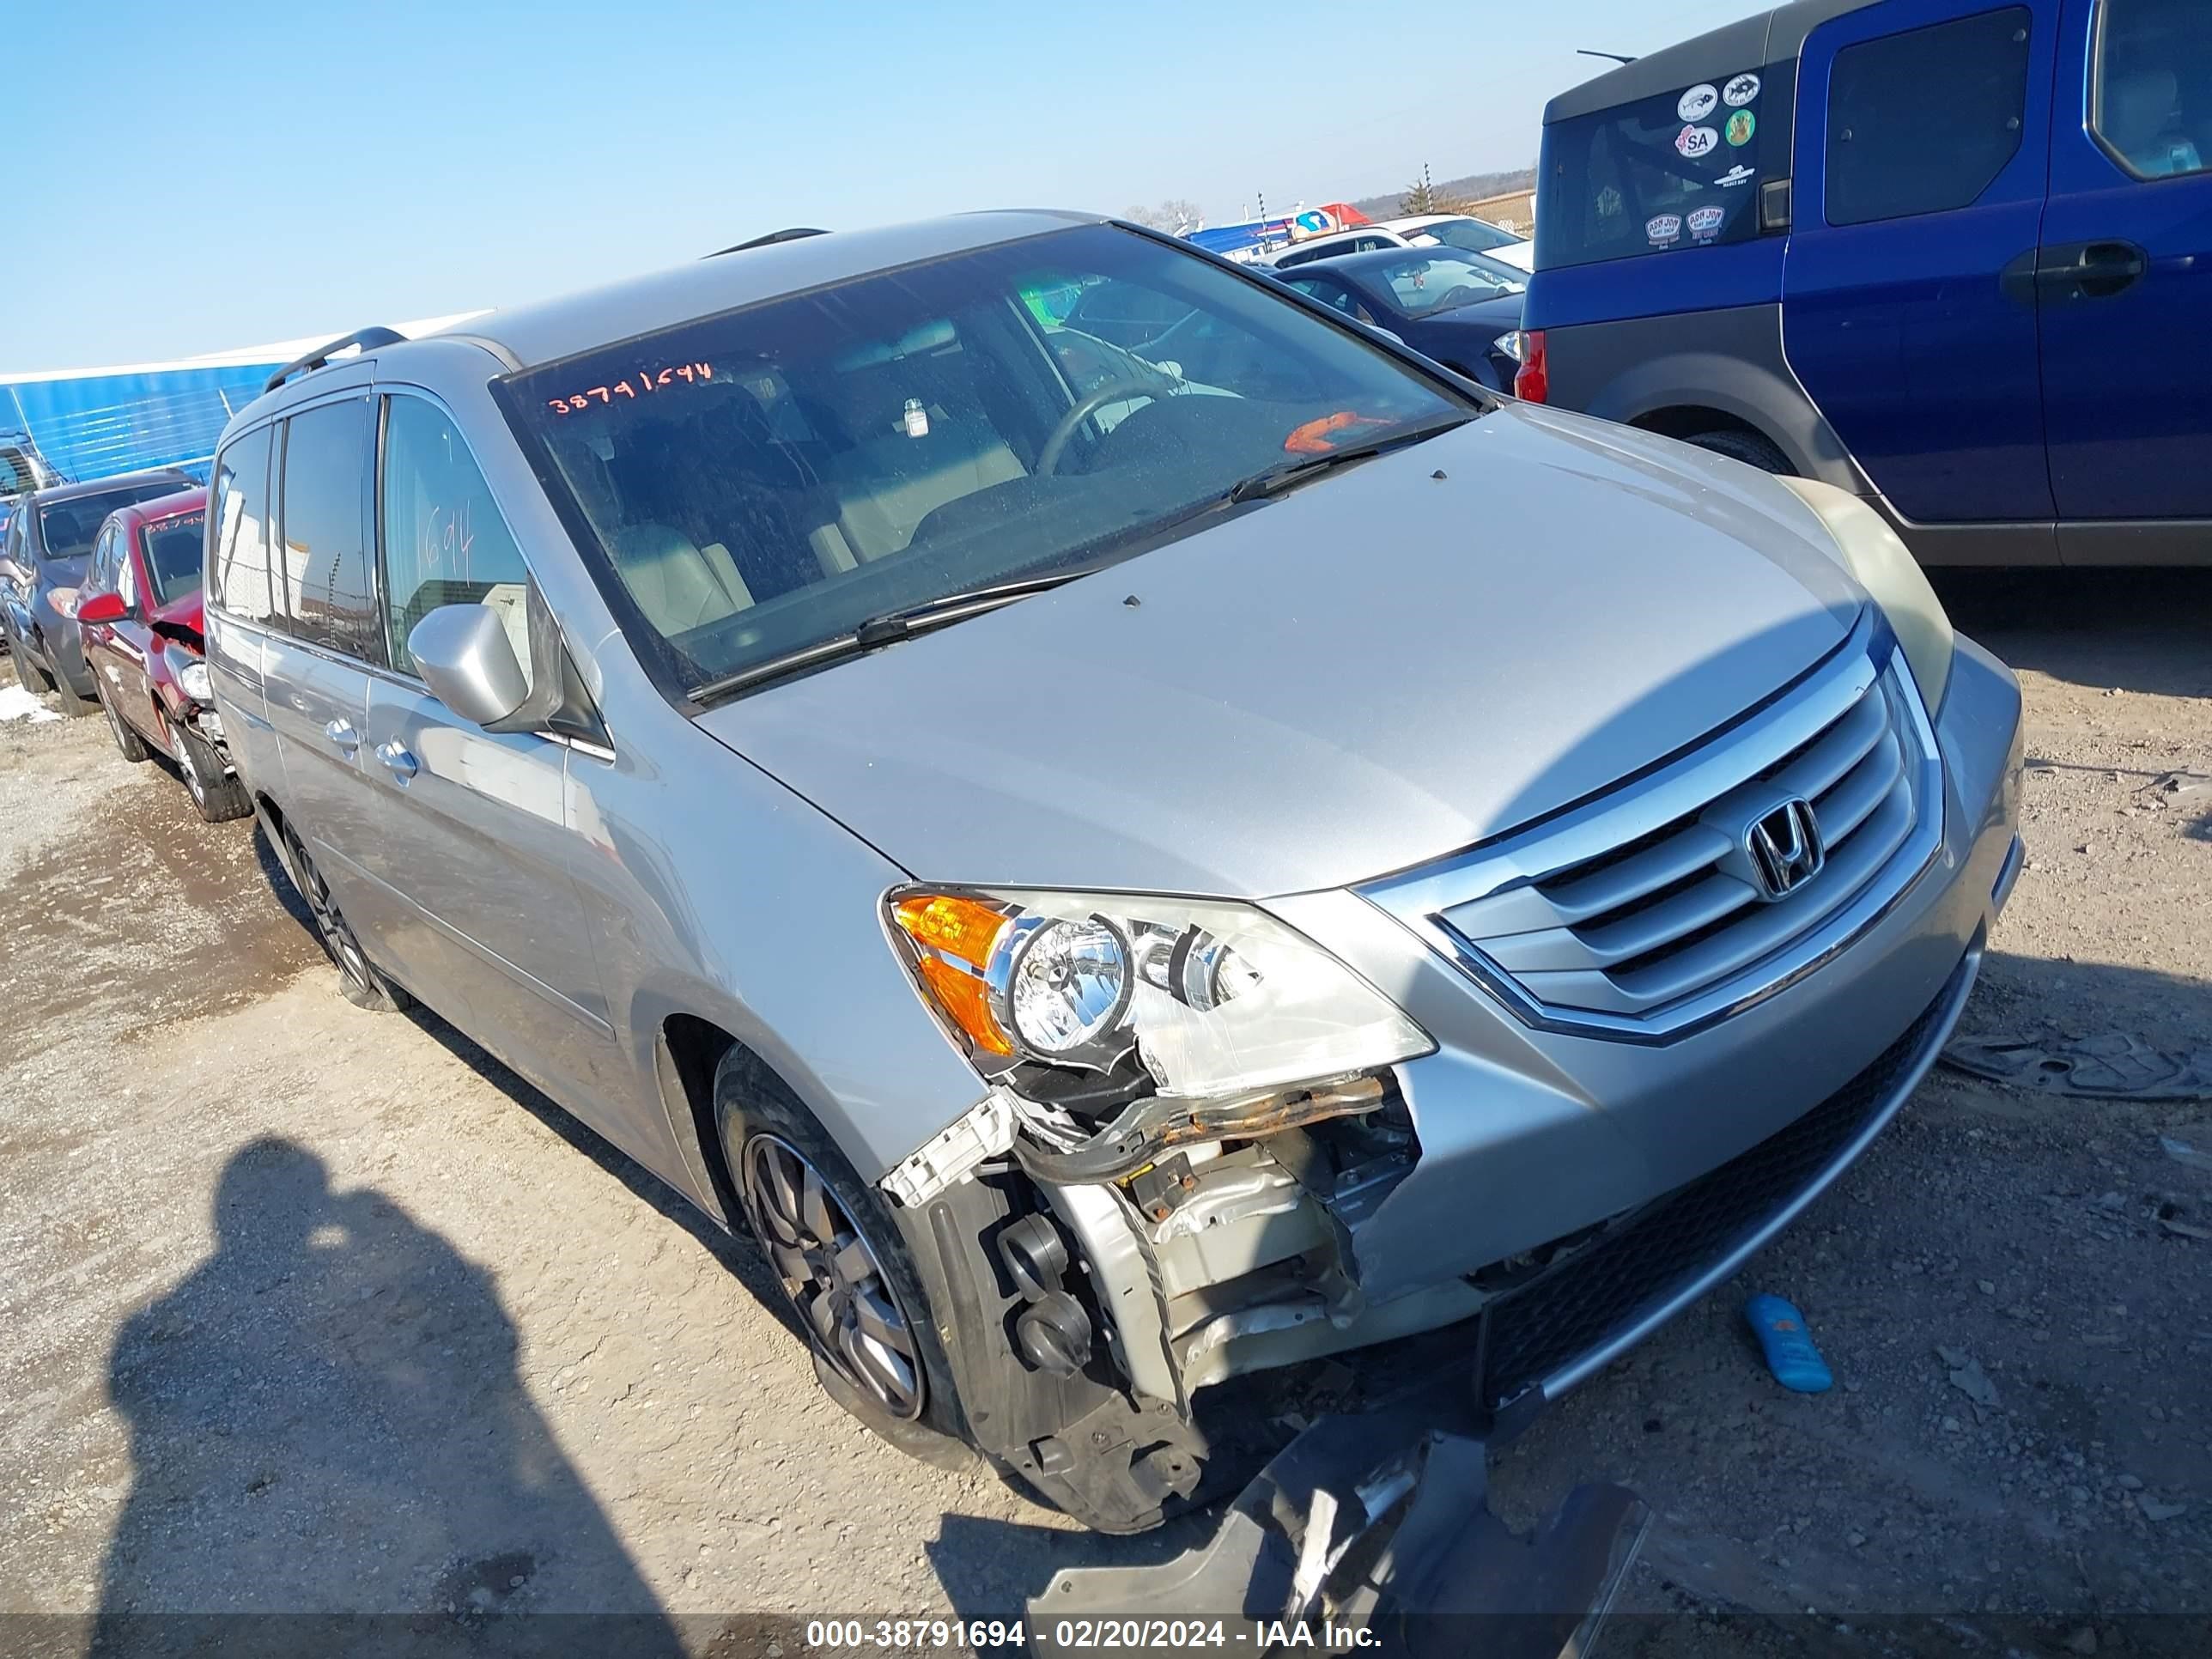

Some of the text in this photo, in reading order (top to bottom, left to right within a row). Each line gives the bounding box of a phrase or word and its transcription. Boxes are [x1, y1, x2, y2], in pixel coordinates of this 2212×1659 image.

[1687, 132, 1709, 150] SA
[1649, 218, 1679, 232] RON JON
[1689, 210, 1722, 225] RON JON
[549, 362, 712, 415] 38791694
